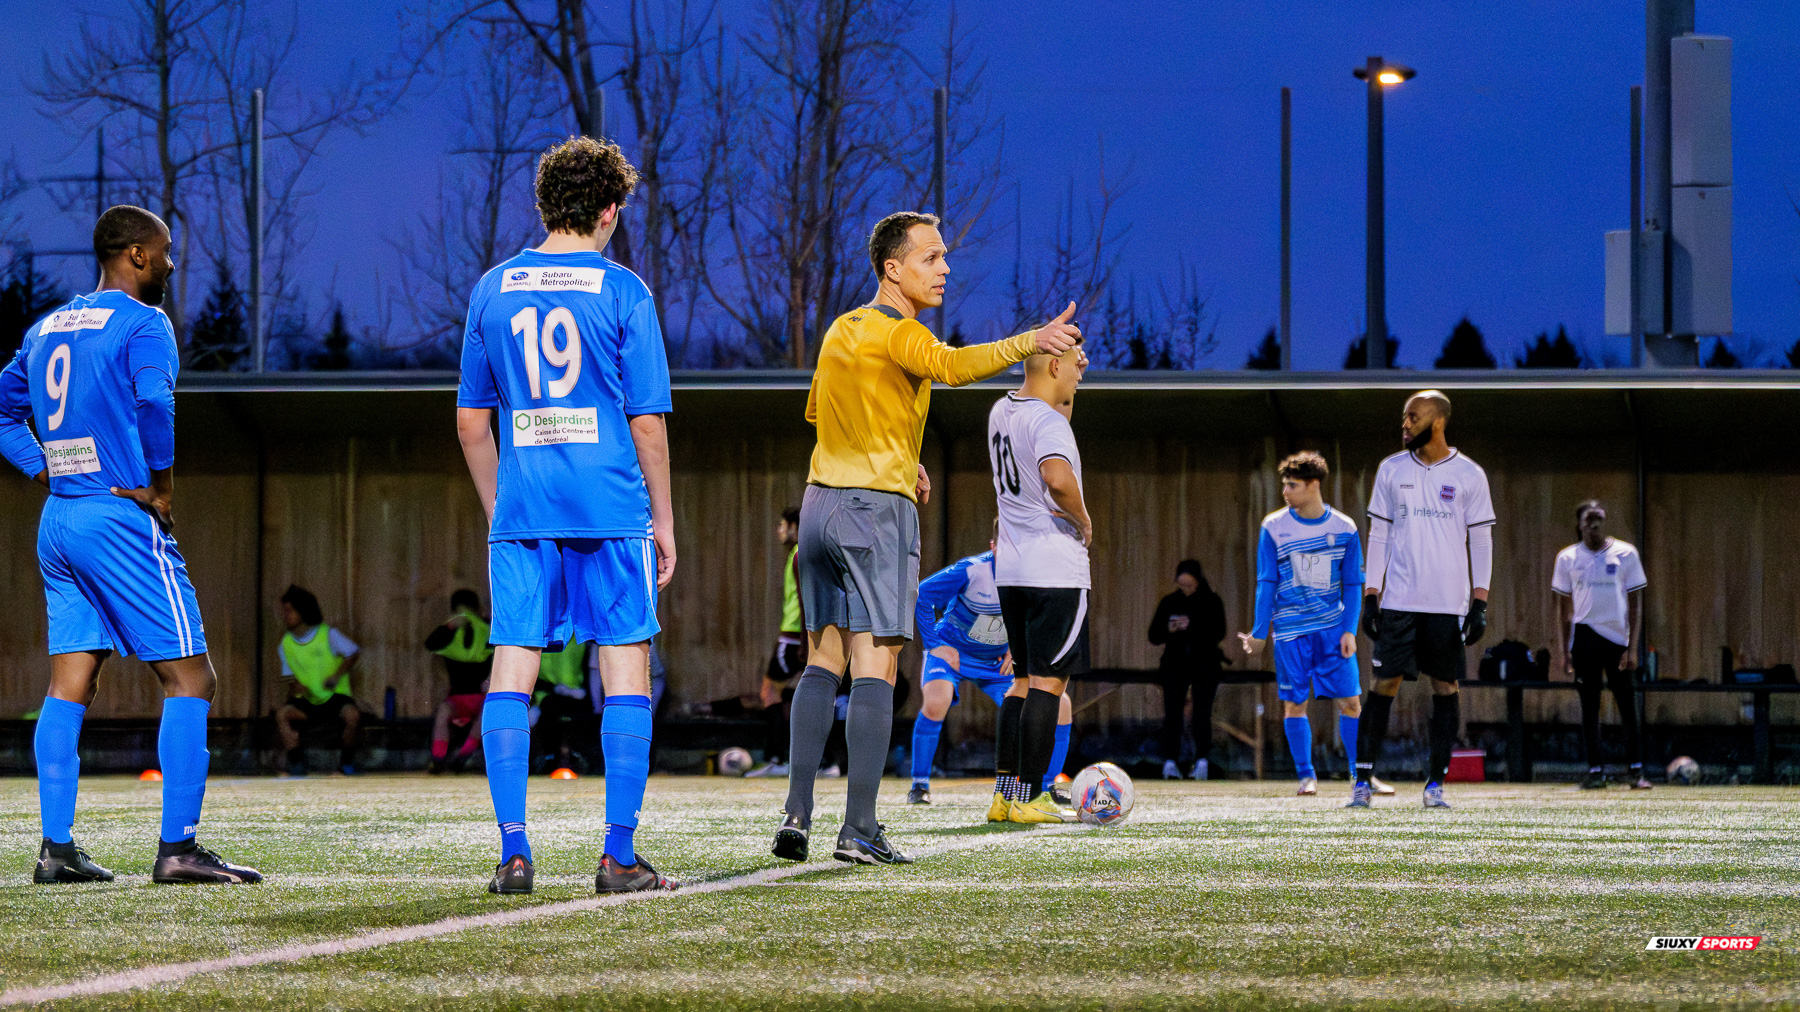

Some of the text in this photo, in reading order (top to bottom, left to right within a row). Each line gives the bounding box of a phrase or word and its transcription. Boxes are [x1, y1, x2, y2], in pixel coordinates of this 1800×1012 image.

[510, 306, 582, 399] 19
[46, 343, 71, 431] 9
[534, 413, 594, 427] Desjardins
[48, 445, 93, 459] Desjardins
[993, 430, 1020, 496] 10
